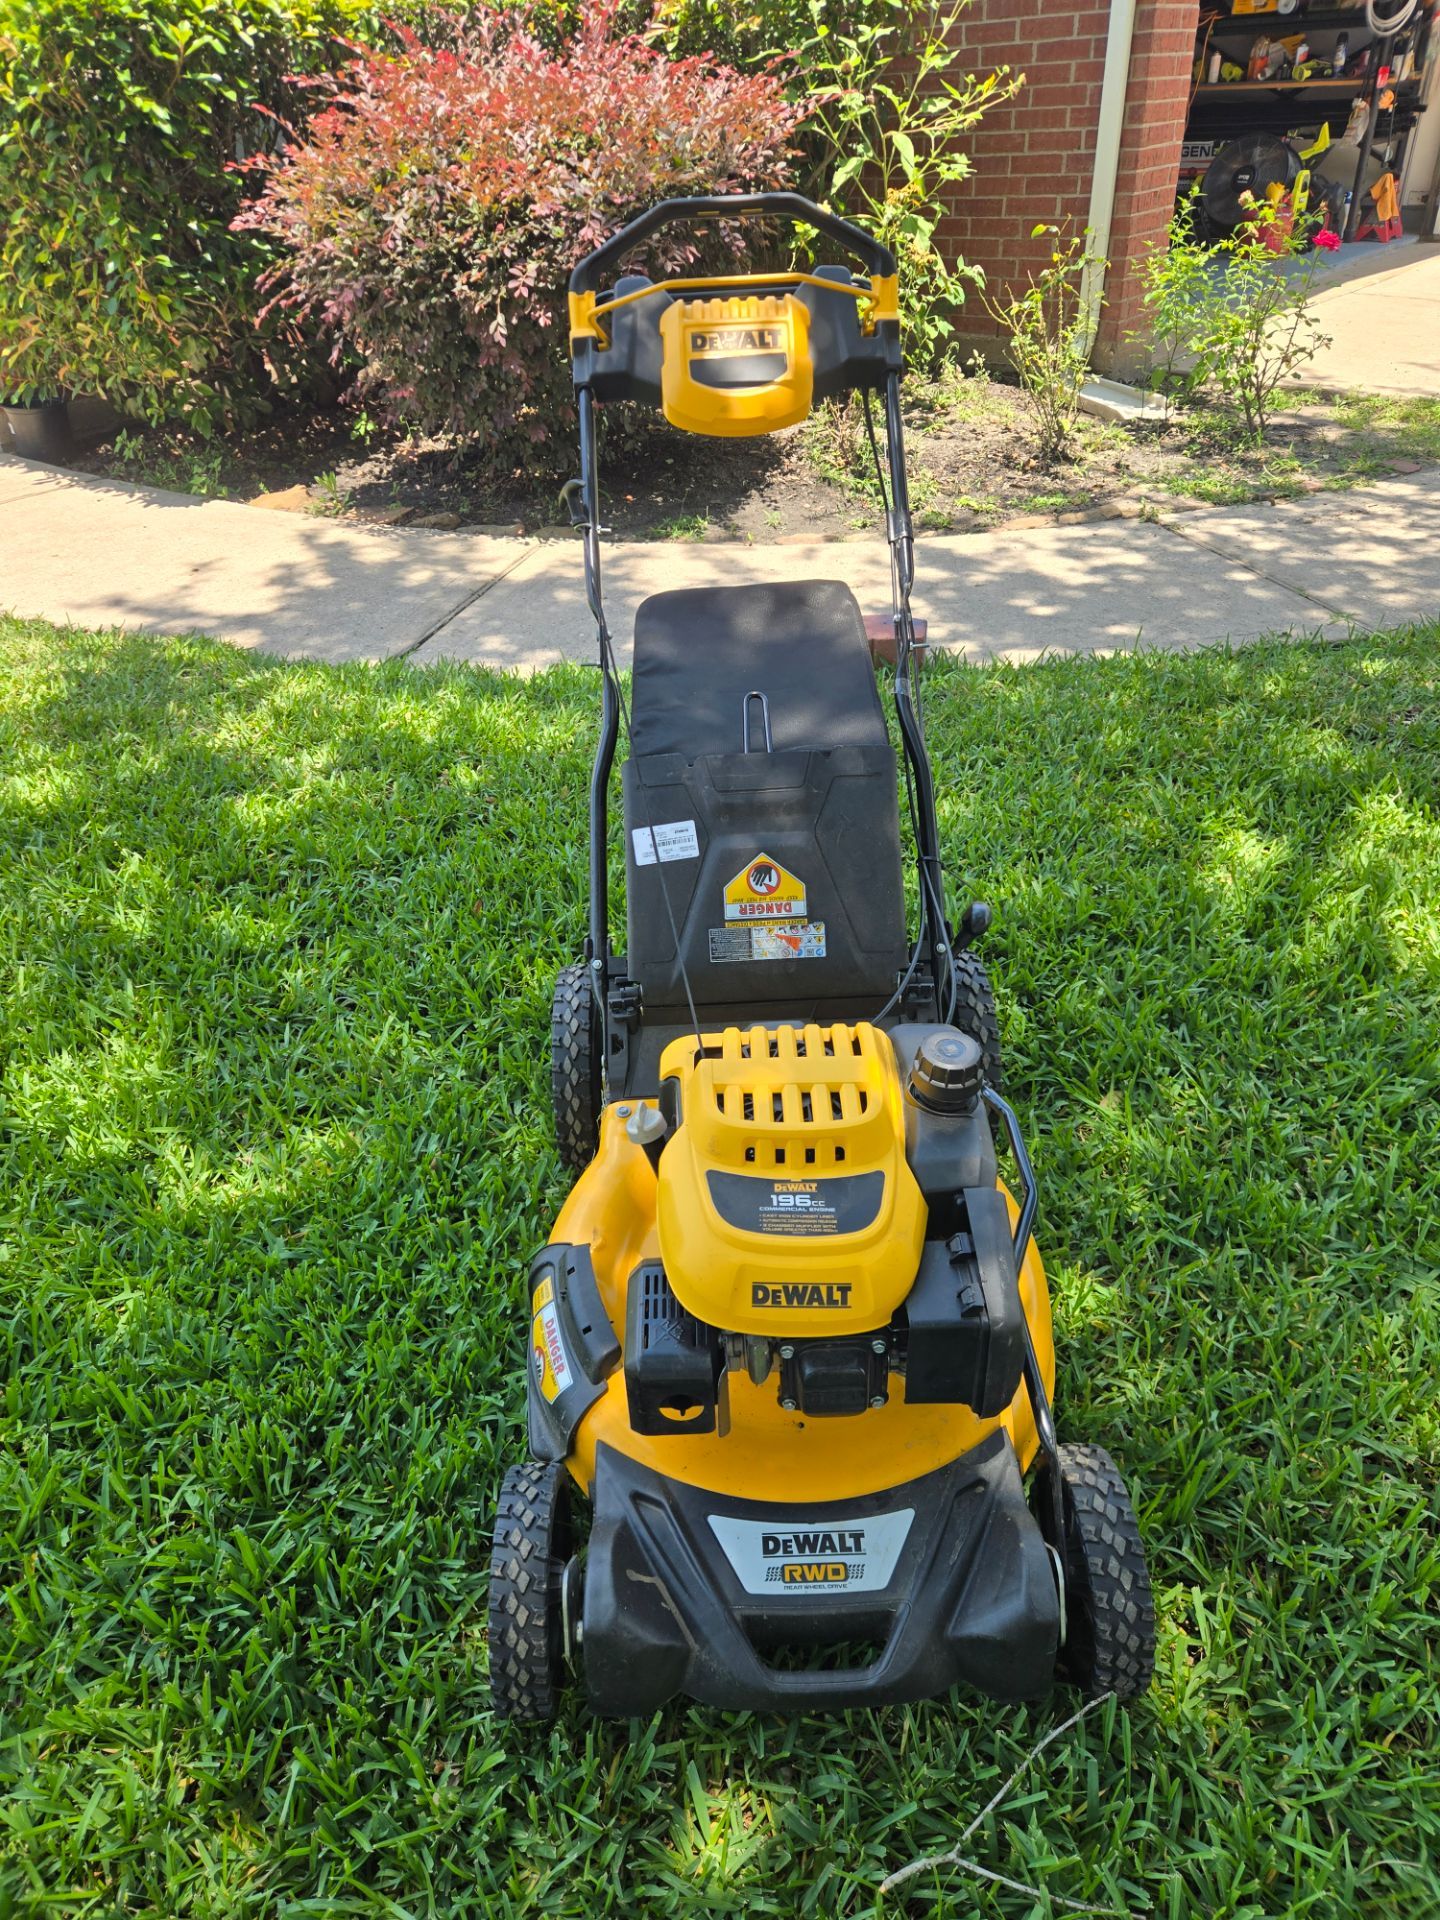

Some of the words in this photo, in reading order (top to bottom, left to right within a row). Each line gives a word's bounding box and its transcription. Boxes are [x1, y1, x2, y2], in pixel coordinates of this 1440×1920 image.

[738, 901, 793, 916] DANGER
[545, 1317, 565, 1376] DANGER
[784, 1563, 846, 1582] RWD
